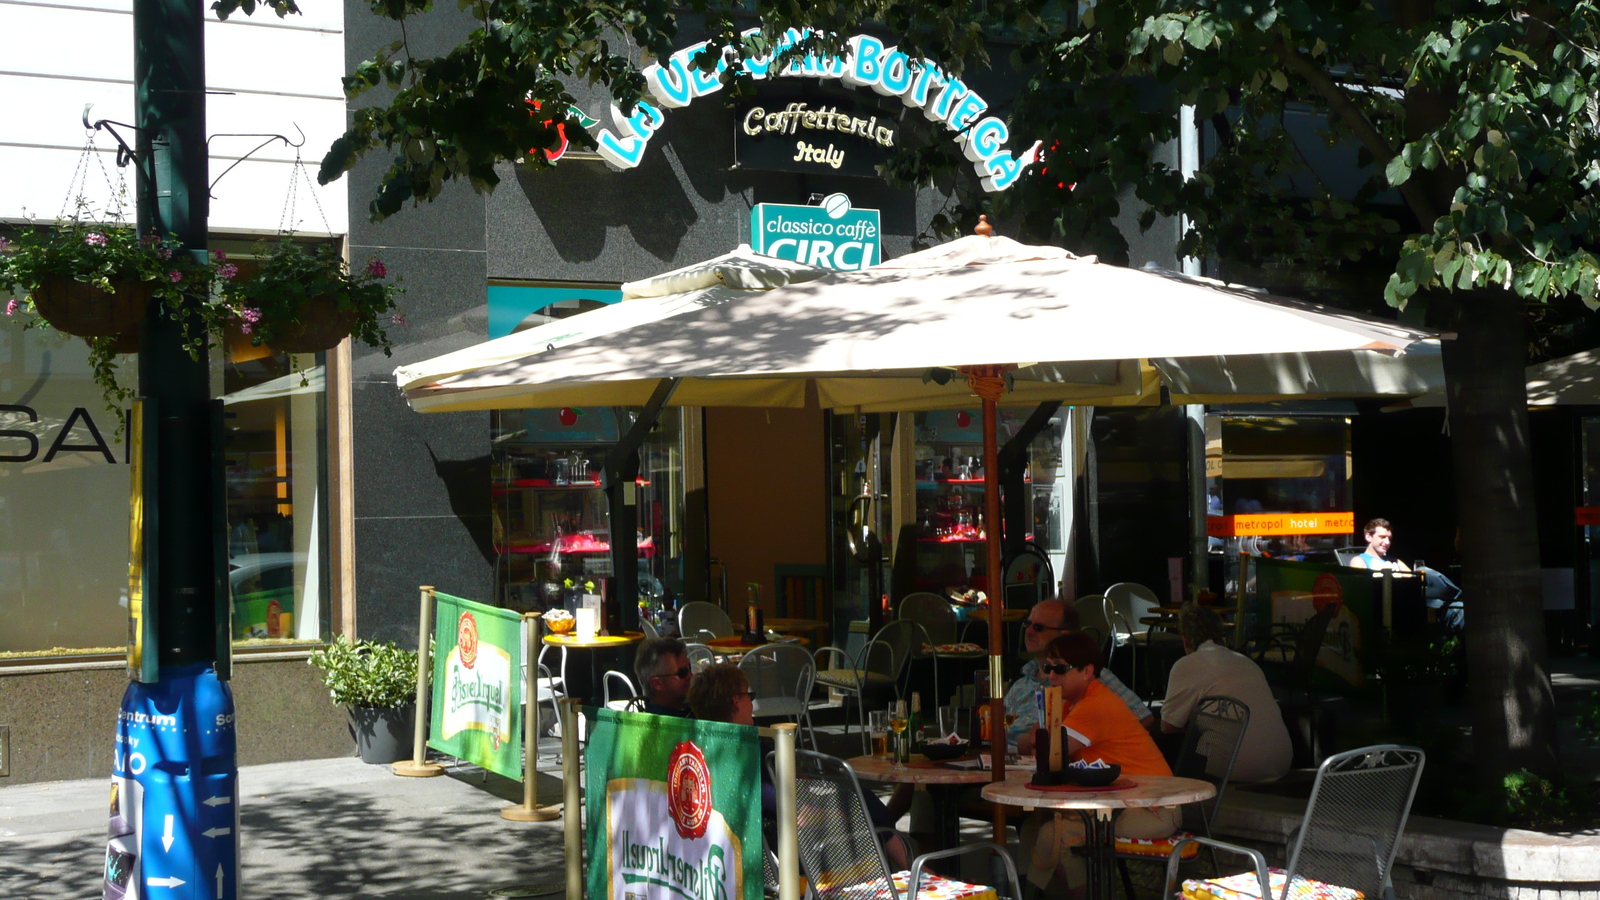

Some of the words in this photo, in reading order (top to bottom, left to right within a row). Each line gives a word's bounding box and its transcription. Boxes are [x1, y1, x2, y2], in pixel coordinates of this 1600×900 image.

[743, 102, 895, 148] Caffetteria
[854, 35, 1023, 192] BOTTEGA
[793, 140, 845, 170] Italy
[766, 215, 833, 237] classico
[836, 219, 876, 241] caffè
[767, 238, 875, 271] CIRCI
[1235, 519, 1284, 532] metropol
[1290, 518, 1319, 529] hotel
